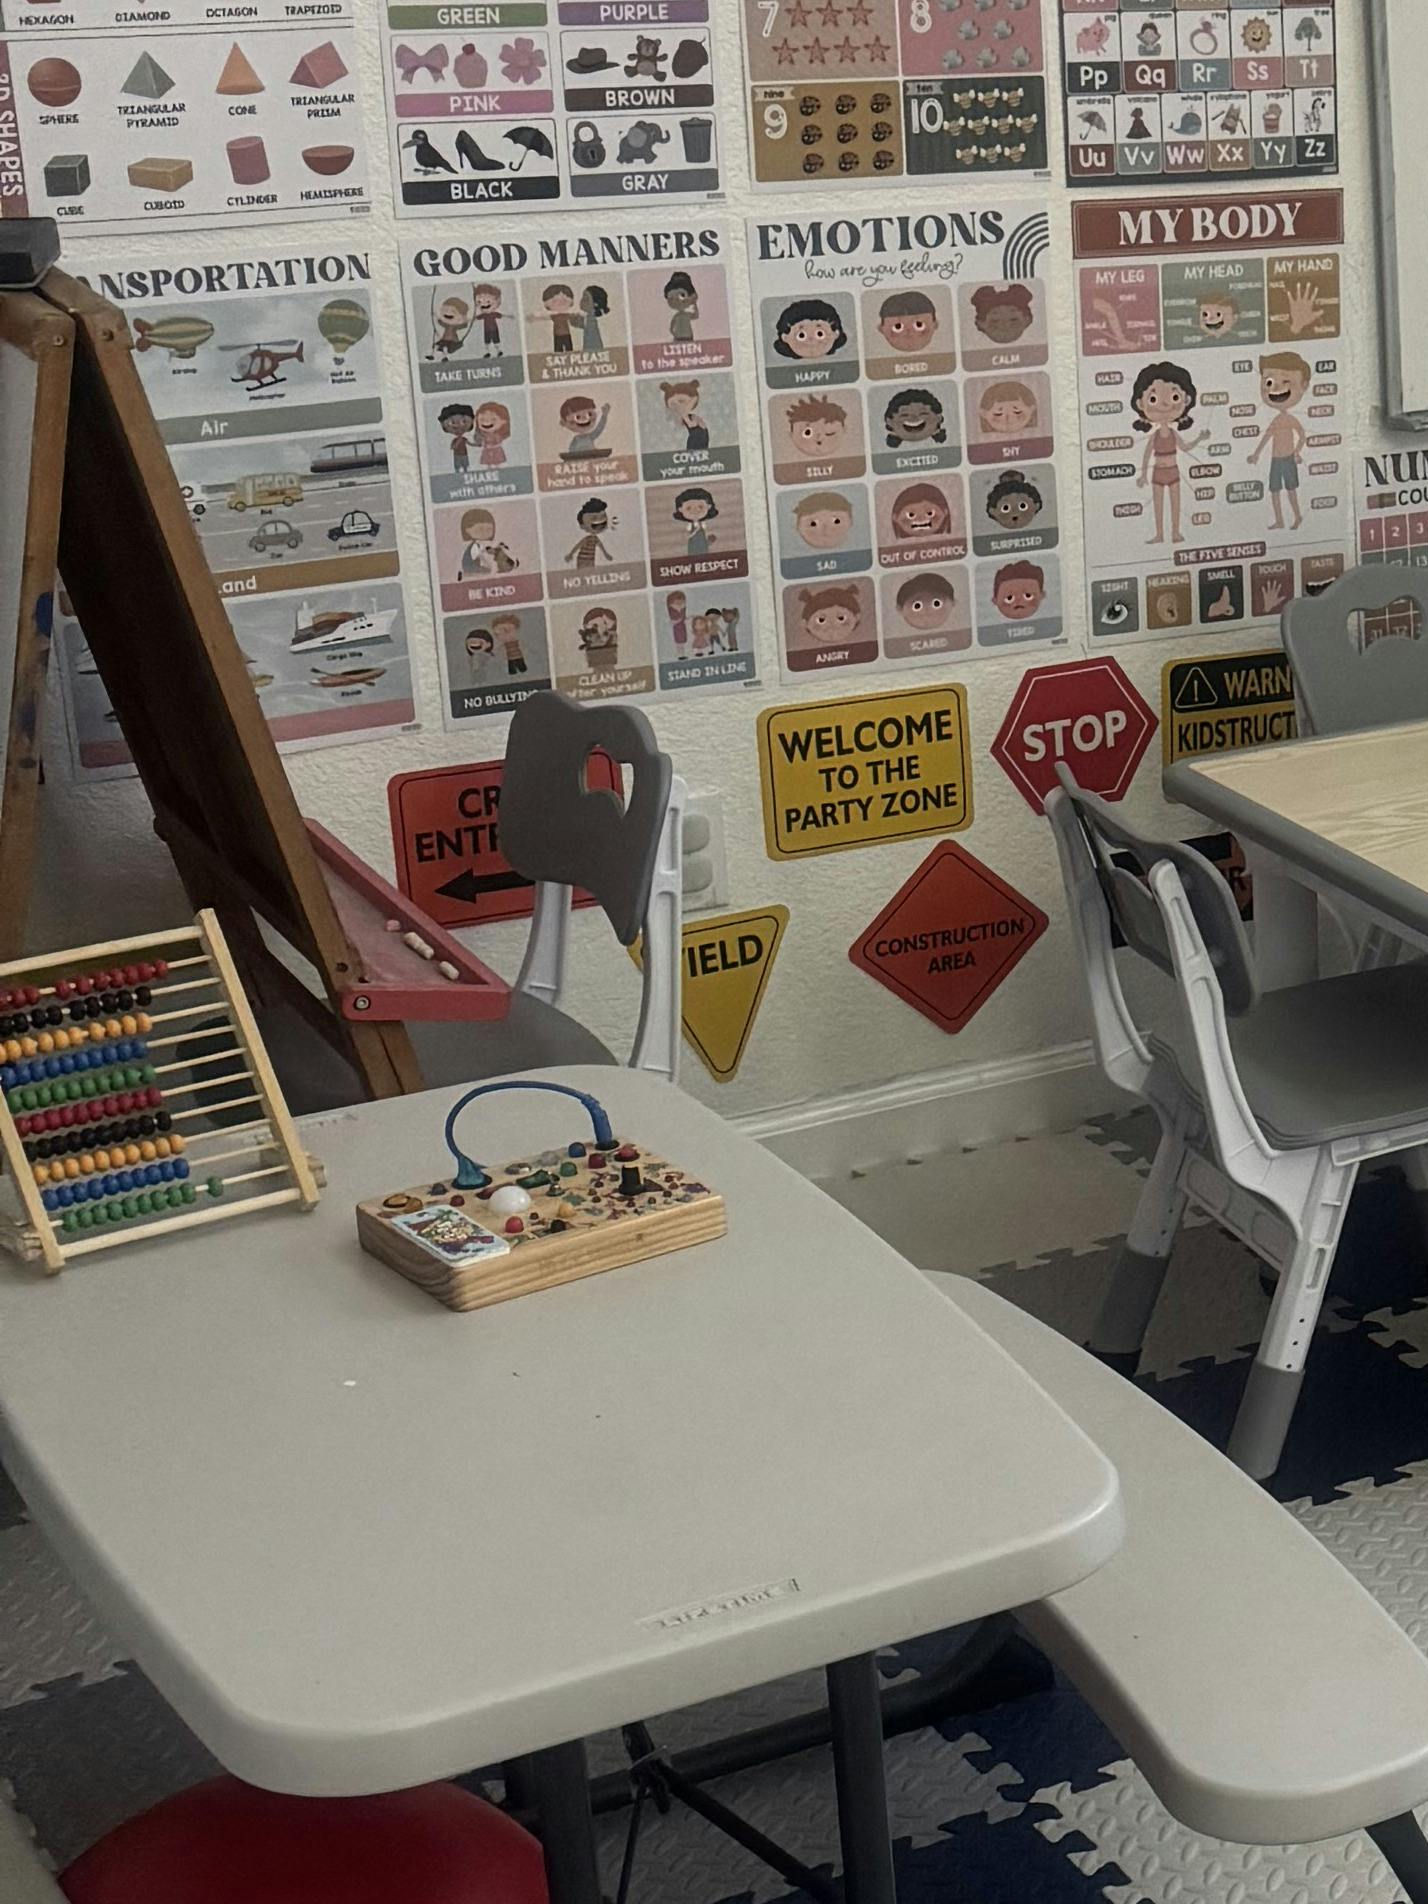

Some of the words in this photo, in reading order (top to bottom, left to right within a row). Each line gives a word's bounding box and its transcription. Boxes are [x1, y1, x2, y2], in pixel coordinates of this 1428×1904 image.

[206, 7, 258, 18] OCTAGON
[437, 6, 500, 25] GREEN
[600, 3, 669, 21] PURPLE
[449, 96, 500, 113] PINK
[605, 88, 674, 107] BROWN
[910, 98, 944, 134] 10
[449, 180, 513, 200] BLACK
[622, 174, 668, 193] GRAY
[1118, 209, 1181, 244] MY
[1191, 202, 1303, 240] BODY
[757, 210, 1005, 261] EMOTIONS
[414, 249, 526, 276] GOOD
[540, 230, 721, 270] MANNERS
[804, 261, 834, 280] how
[838, 266, 862, 278] are
[866, 266, 898, 282] you
[902, 253, 963, 280] feeling?
[1095, 270, 1115, 282] MY
[1119, 268, 1145, 282] LEG
[1184, 266, 1203, 280] MY
[1207, 263, 1244, 277] HEAD
[1274, 260, 1295, 273] MY
[1299, 258, 1332, 271] HAND
[663, 344, 701, 356] LISTEN
[434, 370, 465, 382] TAKE
[469, 367, 502, 380] TURNS
[795, 370, 830, 383] HAPPY
[200, 419, 227, 436] Air
[896, 454, 938, 466] EXCITED
[880, 550, 903, 563] OUT
[907, 549, 921, 560] OF
[925, 546, 965, 559] CONTROL
[1179, 550, 1197, 560] THE
[1201, 549, 1223, 560] FIVE
[1225, 545, 1261, 557] SENSES
[660, 563, 691, 577] SHOW
[694, 560, 739, 574] RESPECT
[779, 712, 953, 763] WELCOME
[1022, 712, 1128, 760] STOP
[818, 764, 859, 790] TO
[868, 757, 921, 786] THE
[784, 798, 872, 834] PARTY
[881, 784, 958, 818] ZONE
[874, 918, 1025, 957] CONSTRUCTION
[928, 951, 976, 974] AREA
